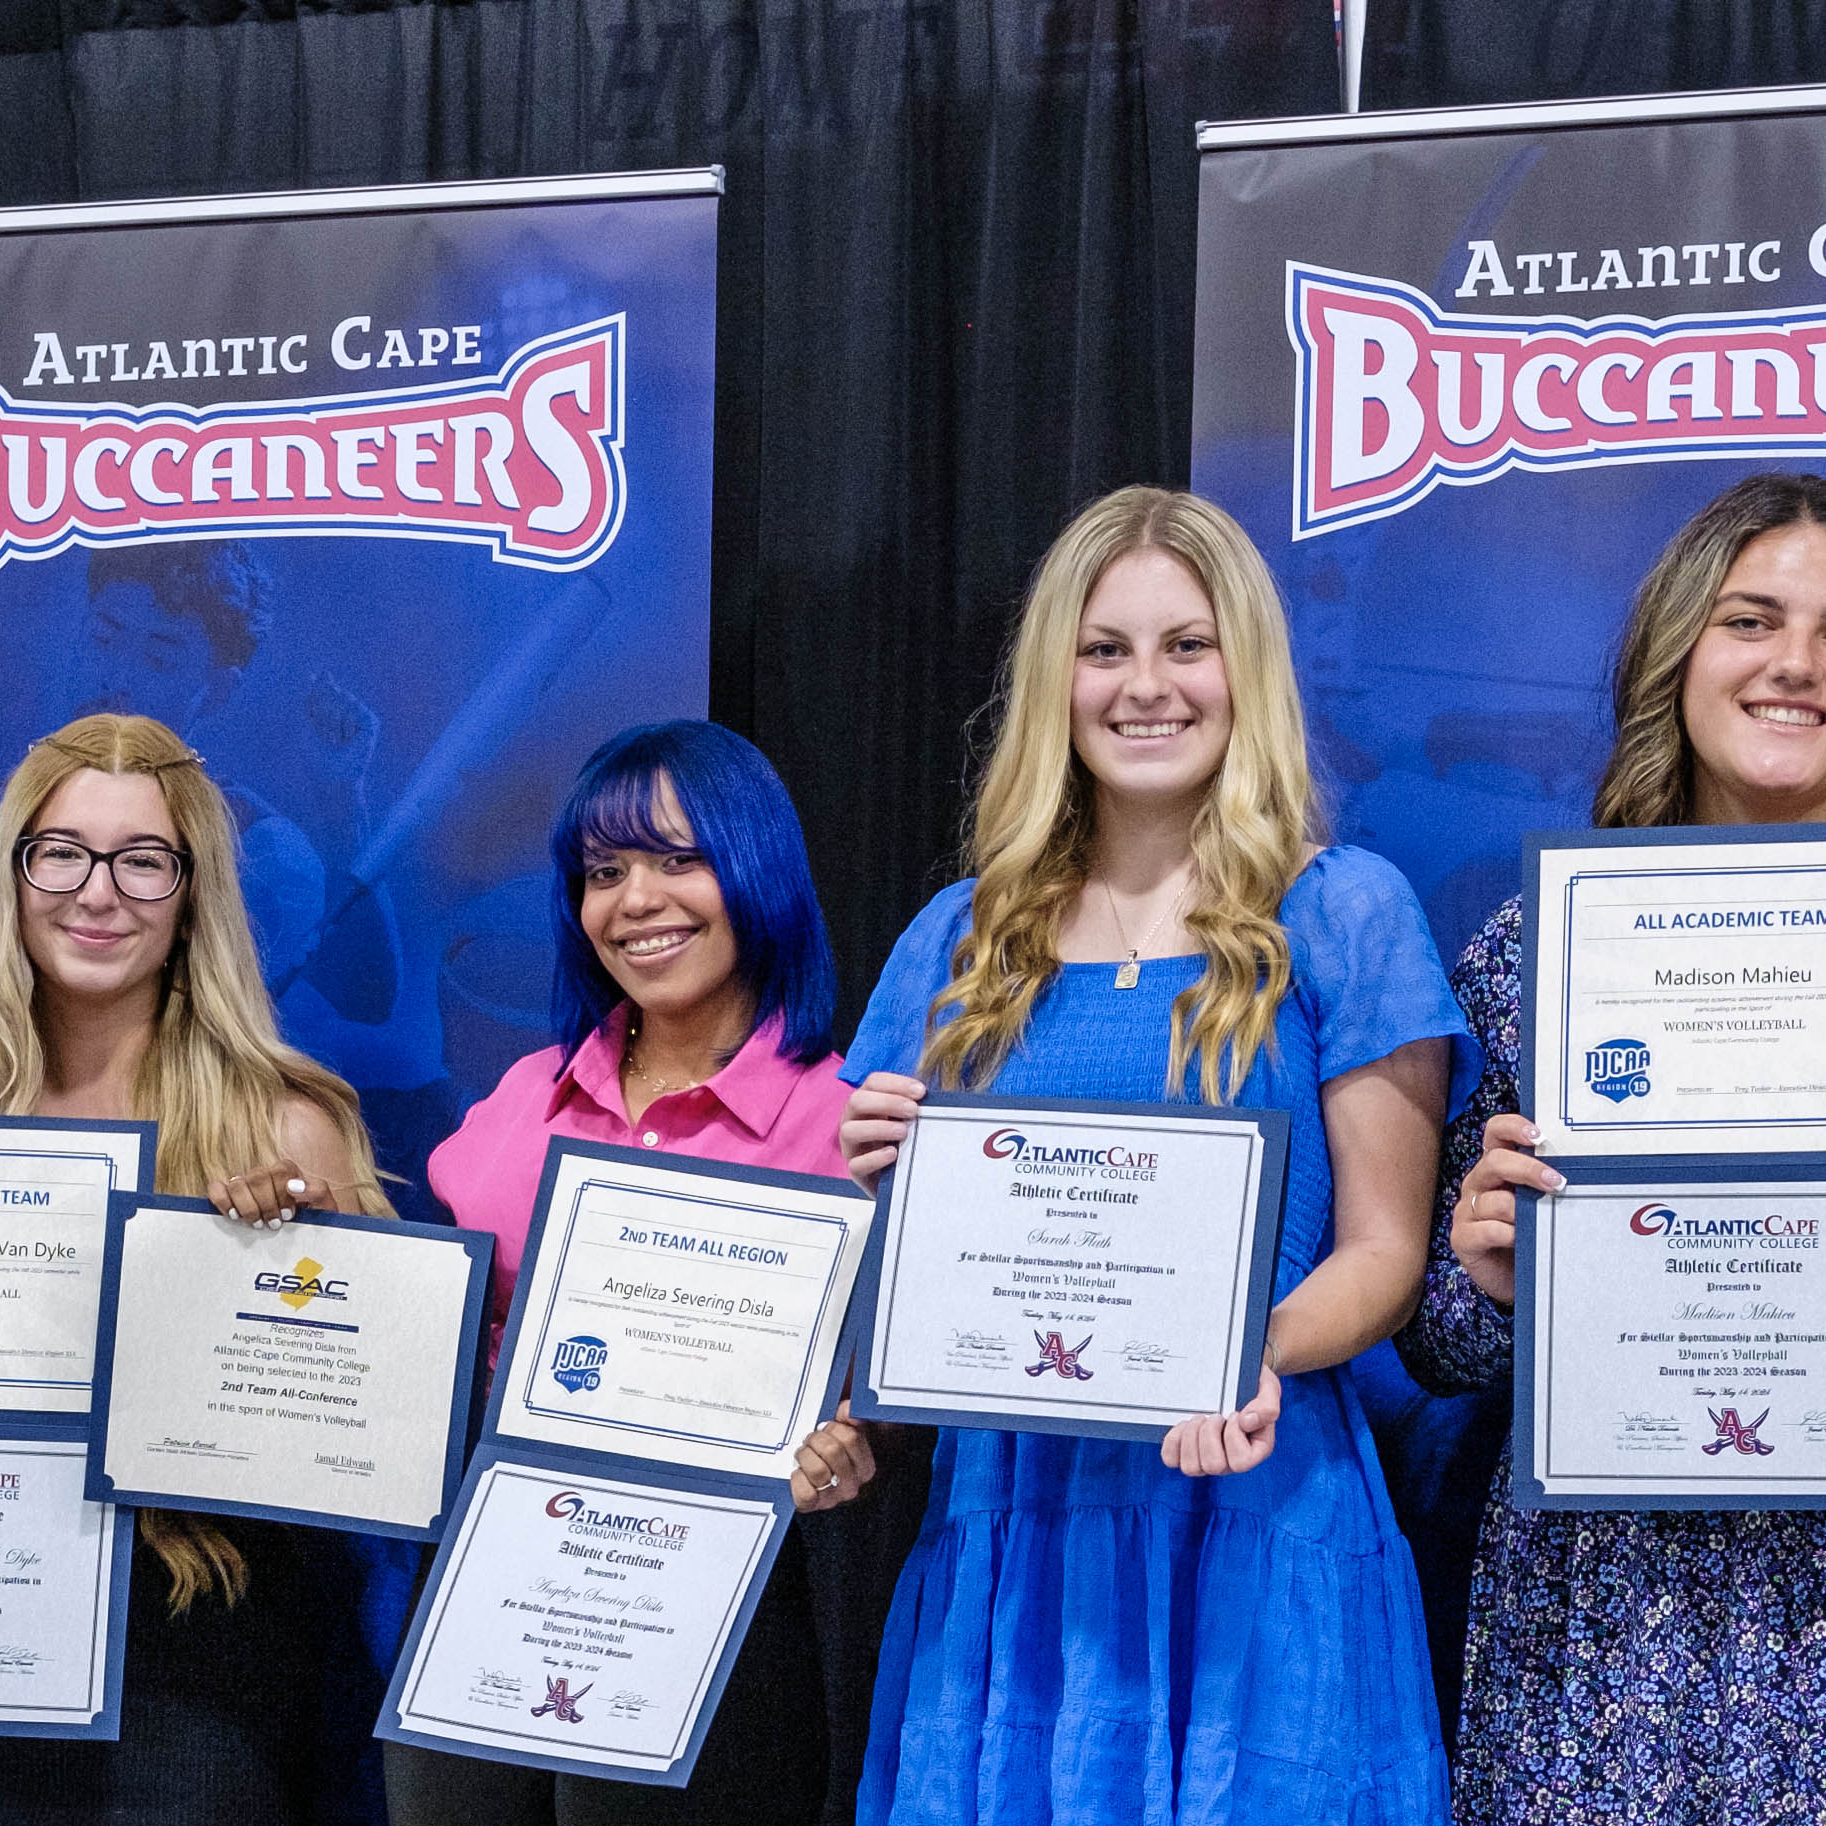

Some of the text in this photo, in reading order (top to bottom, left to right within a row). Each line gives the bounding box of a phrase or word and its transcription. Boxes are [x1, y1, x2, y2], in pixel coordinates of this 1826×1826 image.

[1454, 240, 1782, 299] ATLANTIC
[23, 316, 483, 386] ATLANTIC CAPE
[1634, 912, 1666, 930] ALL
[1671, 911, 1774, 929] ACADEMIC
[1654, 966, 1812, 986] Madison Mahieu
[1664, 1017, 1807, 1032] WOMEN'S VOLLEYBALL
[1585, 1047, 1651, 1084] NJCAA
[1633, 1080, 1648, 1093] 19
[1014, 1163, 1157, 1182] COMMUNITY COLLEGE
[2, 1189, 50, 1206] TEAM
[1009, 1182, 1139, 1206] Athletic Certificate
[619, 1226, 788, 1266] 2ND TEAM ALL REGION
[1027, 1228, 1070, 1246] Sarah
[1667, 1237, 1819, 1249] COMMUNITY COLLEGE
[35, 1241, 77, 1261] Dyke
[1664, 1259, 1803, 1274] Athletic Certificate
[254, 1272, 349, 1295] GSAC
[1063, 1274, 1116, 1289] Volleyball
[1706, 1282, 1761, 1293] Presented to
[603, 1277, 667, 1301] Angeliza
[671, 1287, 735, 1314] Severing
[739, 1298, 774, 1317] Disla
[1671, 1302, 1796, 1320] Madison Mahieu
[270, 1324, 325, 1338] Recognizes
[625, 1327, 734, 1353] WOMEN'S VOLLEYBALL
[1617, 1332, 1637, 1343] For
[1640, 1332, 1675, 1343] Stellar
[1678, 1332, 1751, 1344] Sportsmanship
[1754, 1332, 1771, 1343] and
[232, 1332, 357, 1355] Angeliza Severing Disla from
[214, 1345, 370, 1373] Atlantic Cape Community College
[550, 1343, 608, 1370] NJCAA
[1678, 1349, 1788, 1361] Women's Volleyball
[221, 1362, 361, 1386] on being selected to the 2023
[586, 1374, 599, 1387] 19
[1658, 1366, 1694, 1377] During
[1697, 1367, 1710, 1376] the
[1770, 1367, 1806, 1377] Season
[221, 1381, 358, 1406] 2nd Team All-Conference
[208, 1401, 366, 1429] in the sport of Women's Volleyball
[568, 1524, 684, 1551] COMMUNITY COLLEGE
[4, 1548, 42, 1569] Dyke
[557, 1541, 665, 1571] Athletic Certificate
